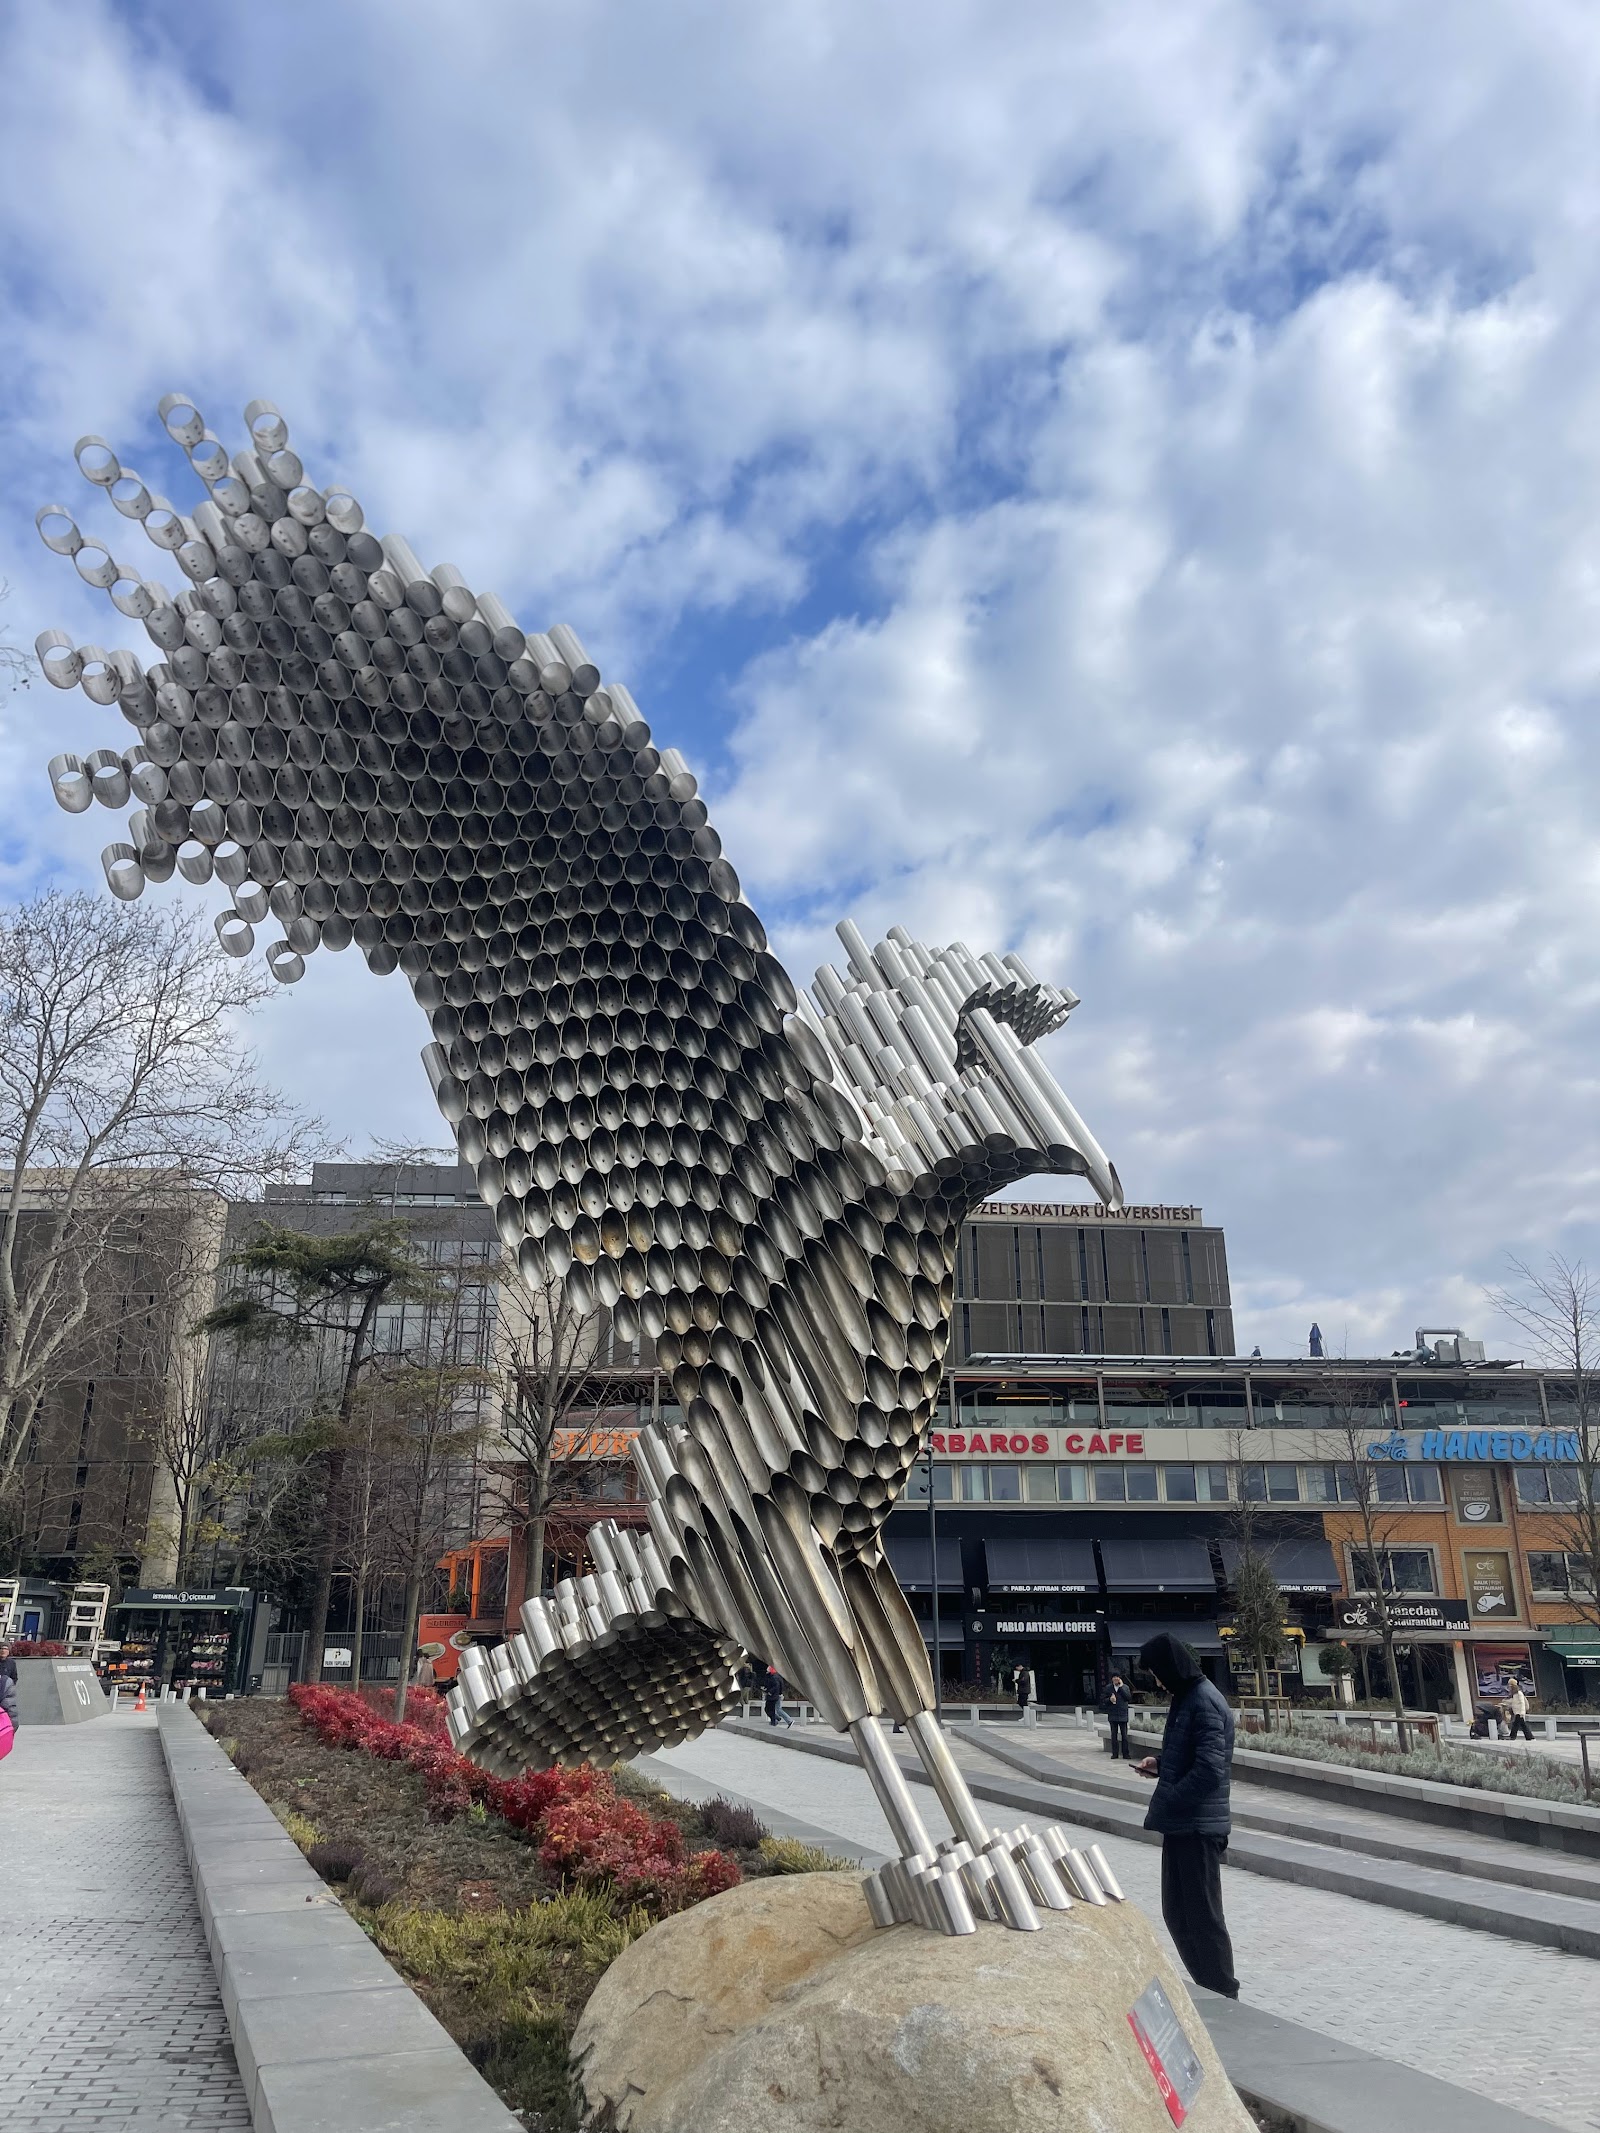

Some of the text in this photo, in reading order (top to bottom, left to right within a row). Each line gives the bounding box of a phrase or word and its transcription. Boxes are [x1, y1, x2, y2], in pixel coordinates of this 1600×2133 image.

[1011, 1203, 1089, 1217] SANATLAR
[920, 1434, 1144, 1453] RBAROS CAFE
[1422, 1430, 1580, 1461] HANEDAN
[996, 1621, 1097, 1632] PABLO ARTISAN COFFEE
[1446, 1621, 1470, 1630] Balık
